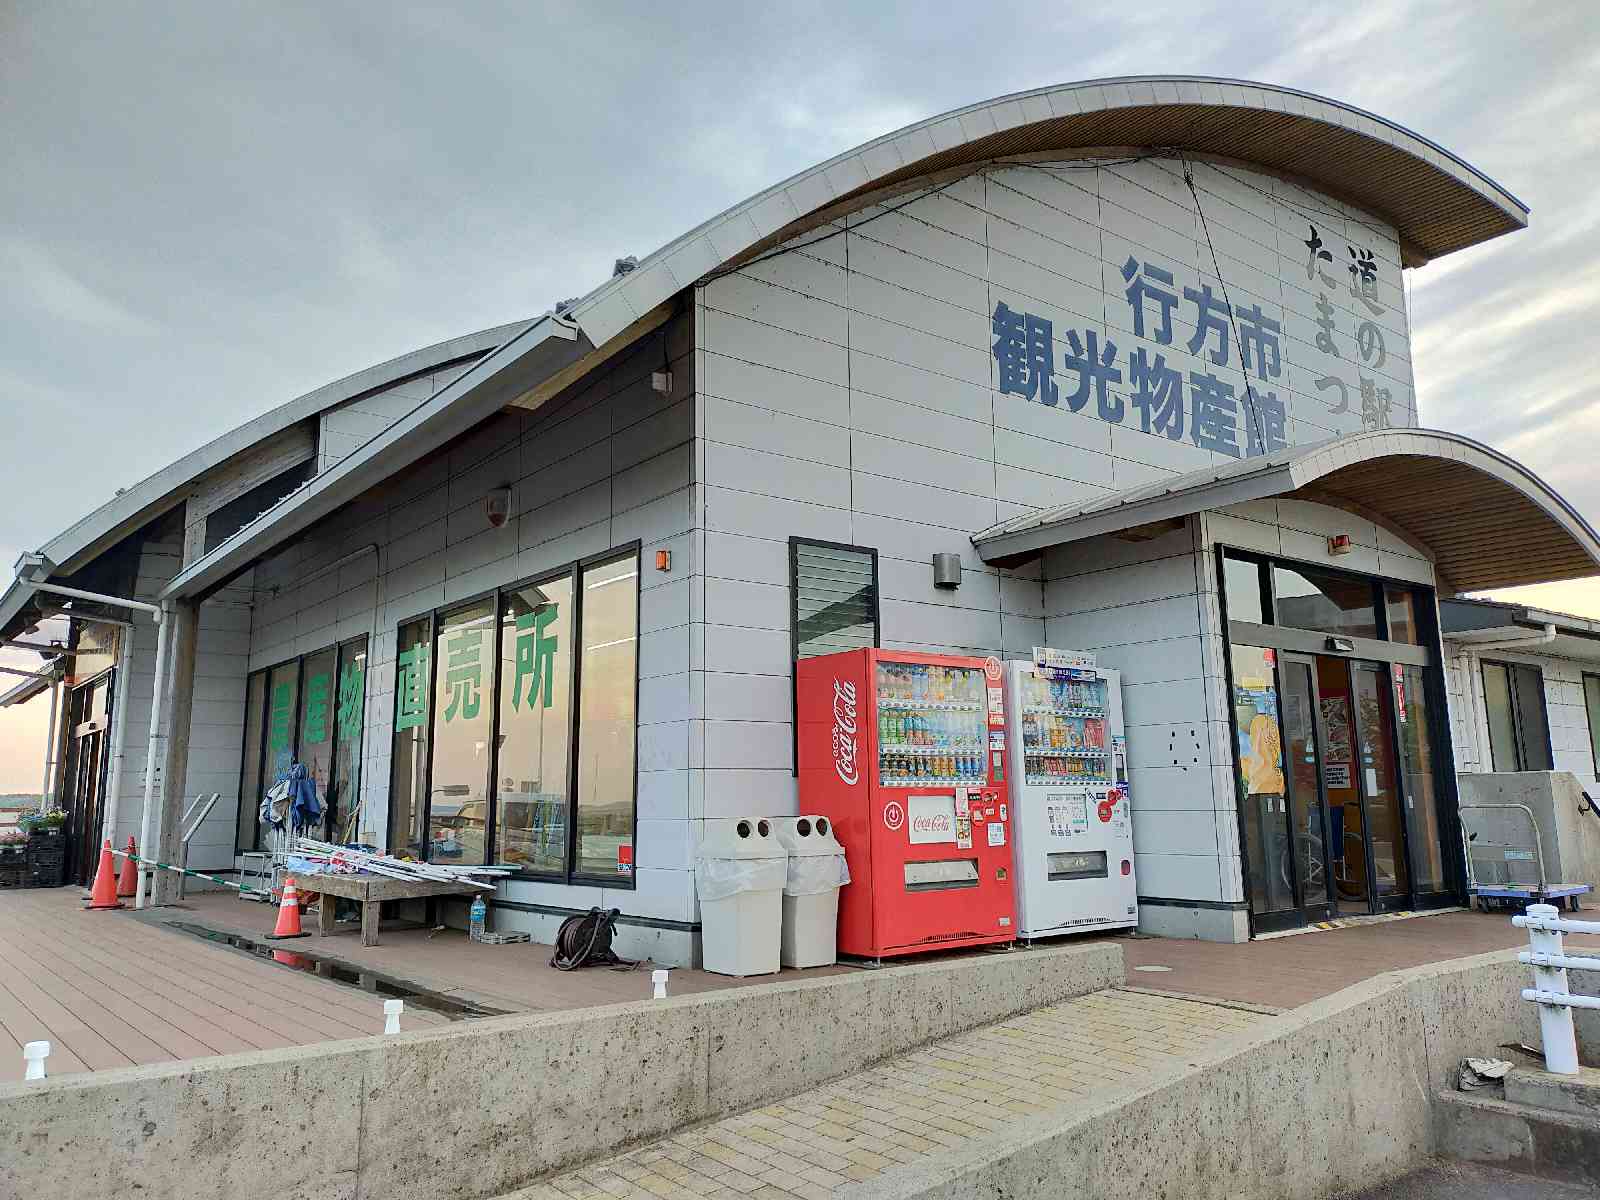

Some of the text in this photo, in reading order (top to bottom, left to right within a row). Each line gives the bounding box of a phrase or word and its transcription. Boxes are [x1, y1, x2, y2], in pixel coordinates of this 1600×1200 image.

[991, 301, 1288, 458] 観光物産館
[1120, 255, 1282, 382] 行方市
[396, 602, 559, 733] 直売所
[833, 676, 858, 785] Coca-Cola
